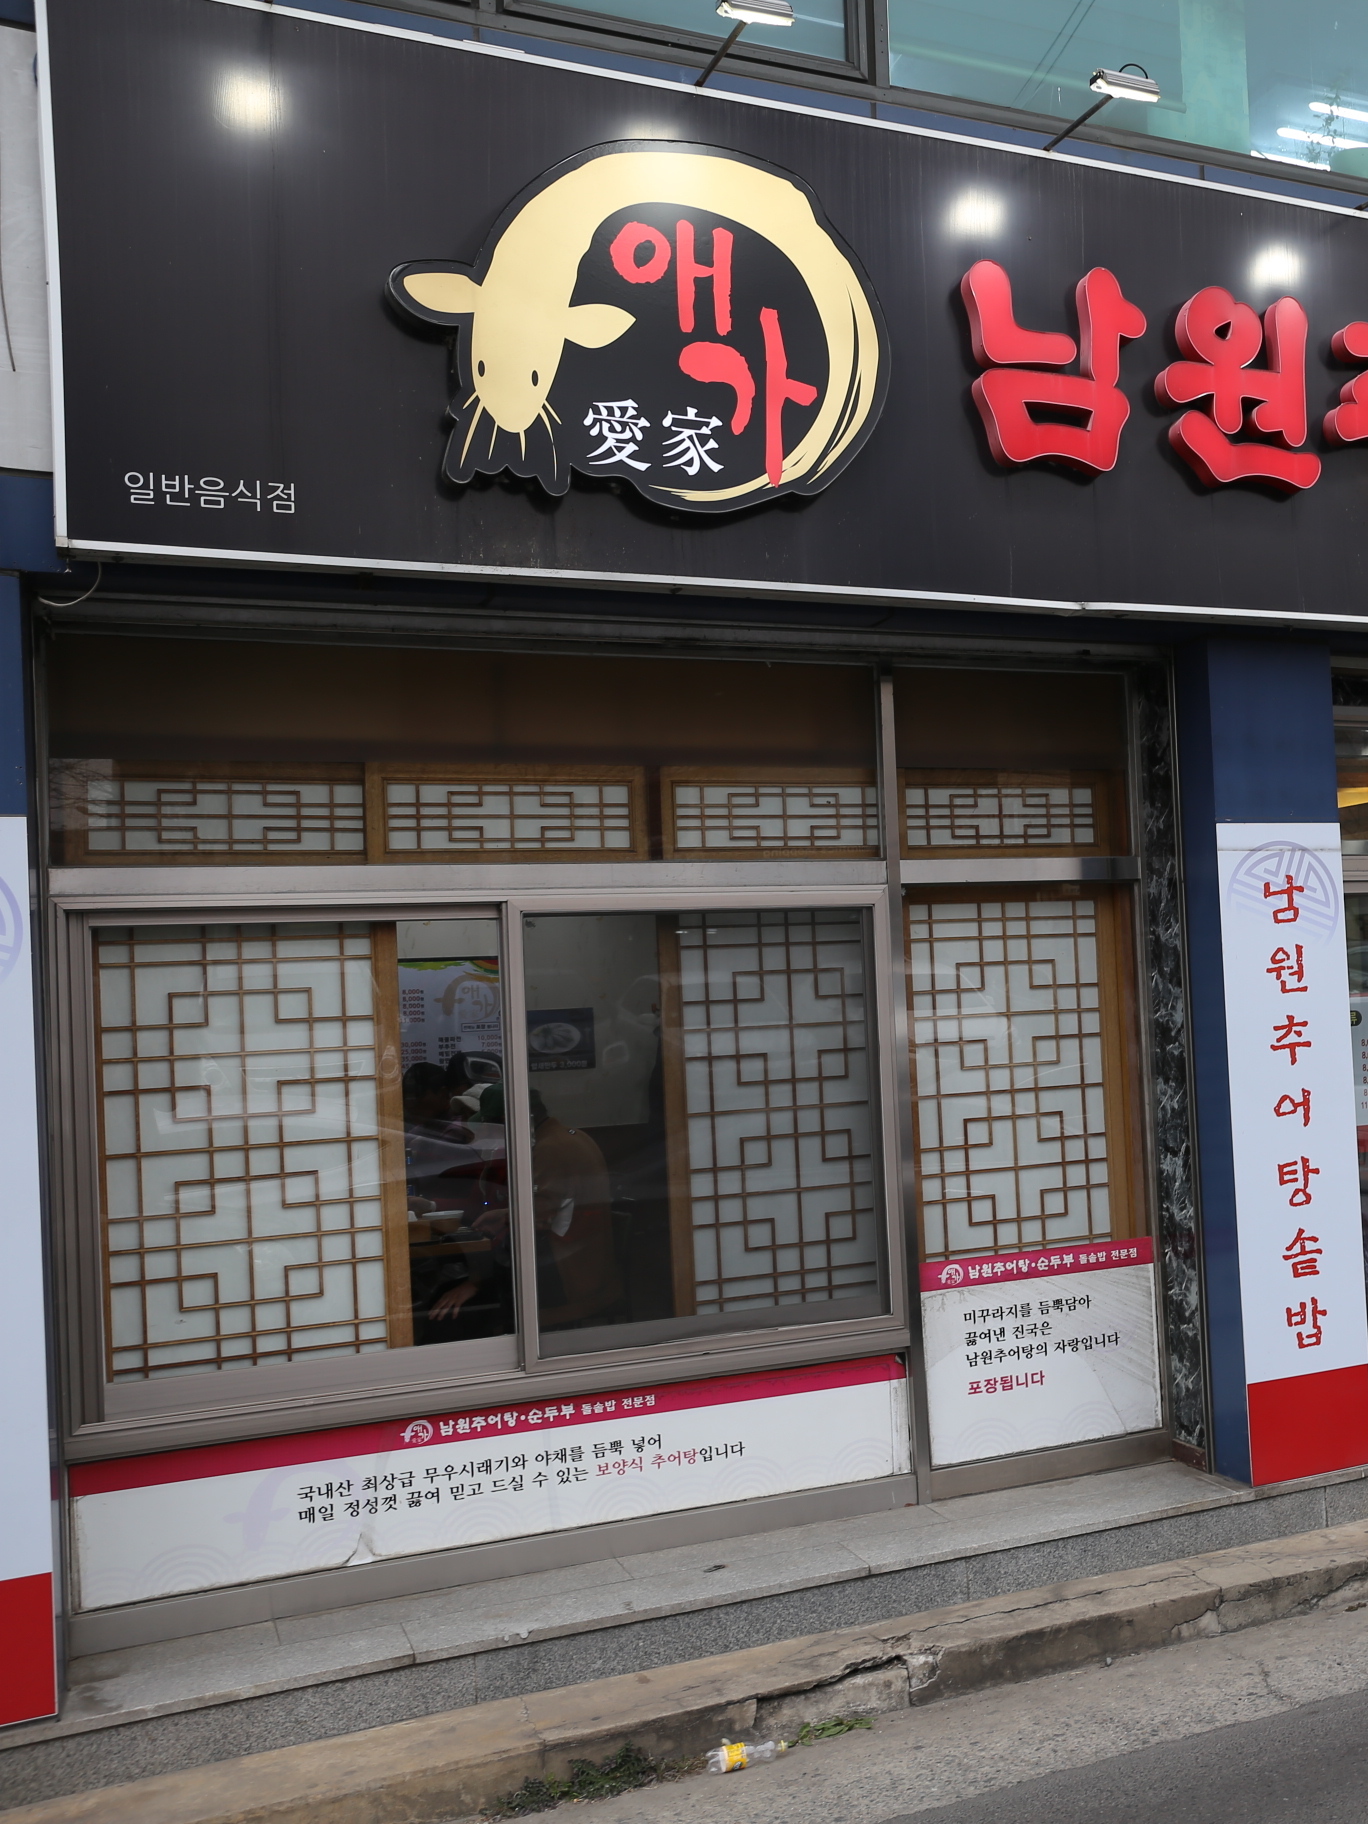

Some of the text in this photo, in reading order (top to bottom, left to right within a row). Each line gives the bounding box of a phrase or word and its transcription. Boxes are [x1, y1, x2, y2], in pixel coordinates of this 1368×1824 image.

[609, 219, 818, 488] 애가
[583, 399, 725, 475] 愛家
[124, 471, 296, 514] 일반음식점
[1079, 1251, 1107, 1265] 돌솥밥
[1110, 1247, 1138, 1261] 전문점
[963, 1294, 1092, 1325] 미꾸라지를 듬뿍담아
[964, 1320, 1053, 1347] 끓여낸 진국은
[965, 1331, 1121, 1368] 남원추어탕의 자랑입니다
[967, 1370, 1046, 1396] 포장됩니다
[581, 1399, 616, 1416] 돌솥밥
[621, 1394, 656, 1410] 전문점
[297, 1434, 662, 1503] 국내산 최상급 무우시래기와 야채를 듬뿍 넣어
[298, 1441, 746, 1524] 매일 정성껏 끓여 믿고 드실 수 있는 보양식 추어탕입니다
